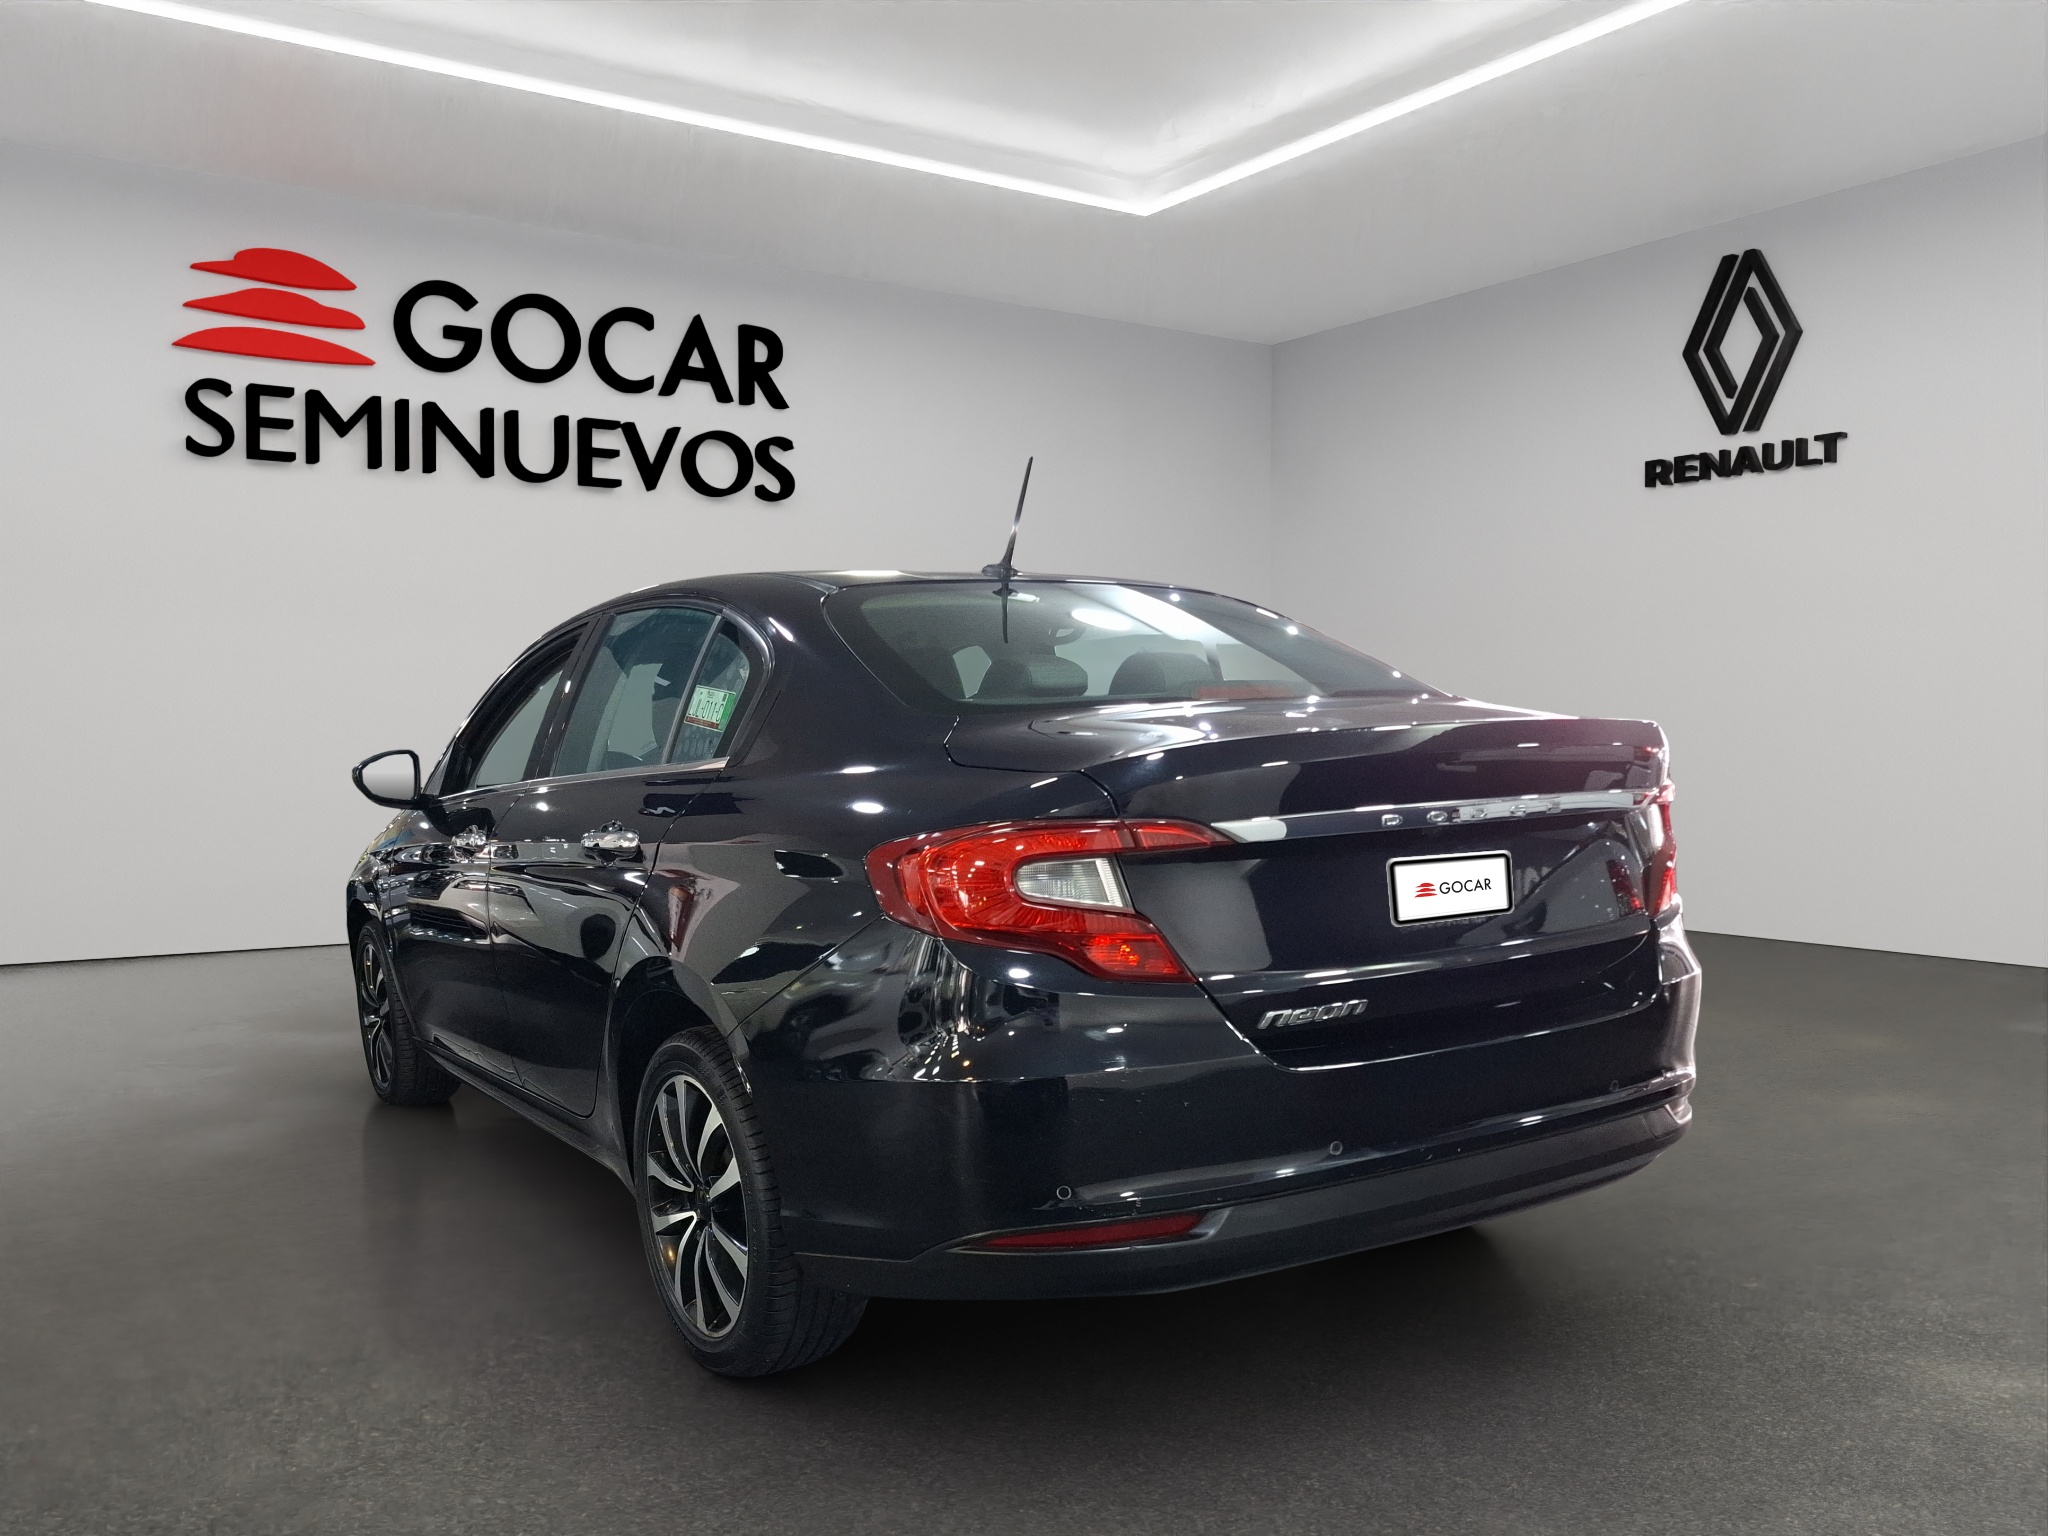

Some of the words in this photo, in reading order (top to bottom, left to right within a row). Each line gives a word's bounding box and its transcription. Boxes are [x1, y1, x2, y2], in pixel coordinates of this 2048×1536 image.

[393, 280, 790, 410] GOCAR
[185, 378, 796, 503] SEMINUEVOS
[1645, 431, 1848, 488] RENAULT
[1382, 802, 1562, 827] DODGE
[1439, 878, 1492, 895] GOCAR
[1257, 999, 1369, 1030] neon
